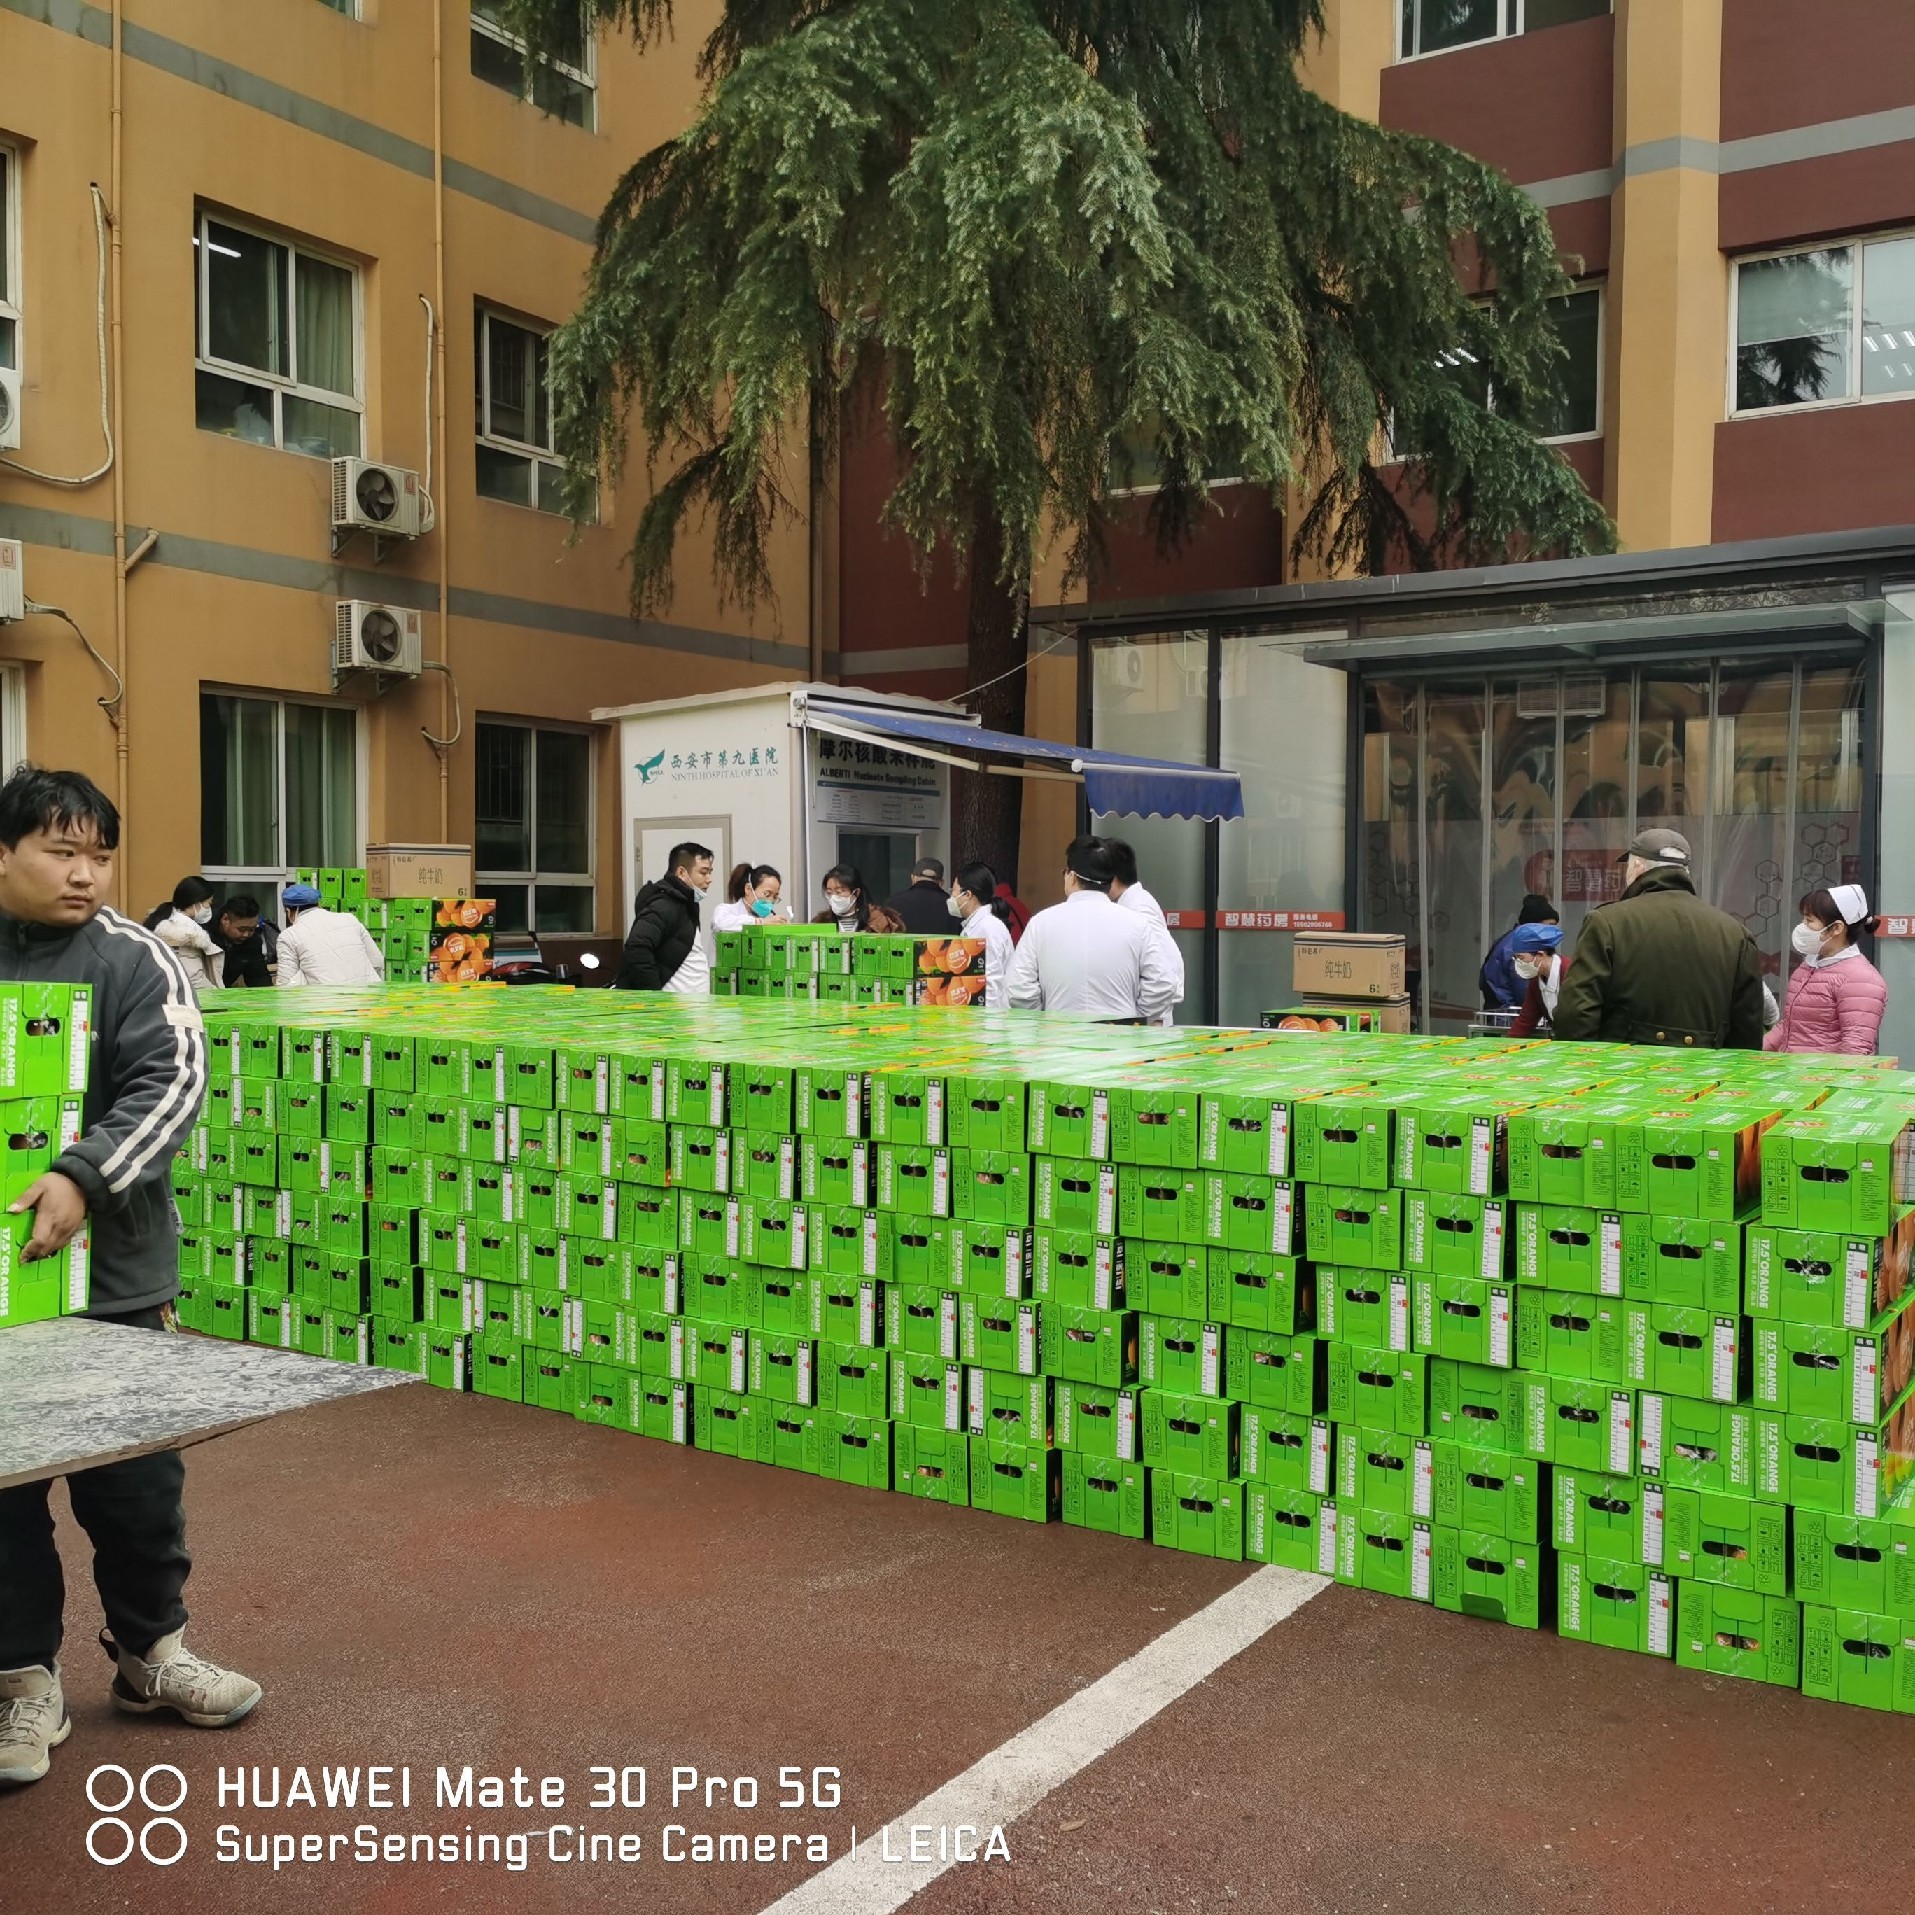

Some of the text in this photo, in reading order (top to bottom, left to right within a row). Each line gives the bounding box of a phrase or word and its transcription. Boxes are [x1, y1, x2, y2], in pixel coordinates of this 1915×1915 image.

[670, 747, 778, 769] 西安市第九医院
[671, 772, 698, 781] NINTH
[699, 770, 740, 780] HOSPITAL
[1225, 913, 1288, 927] 智慧药房
[1324, 960, 1352, 979] 纯牛奶
